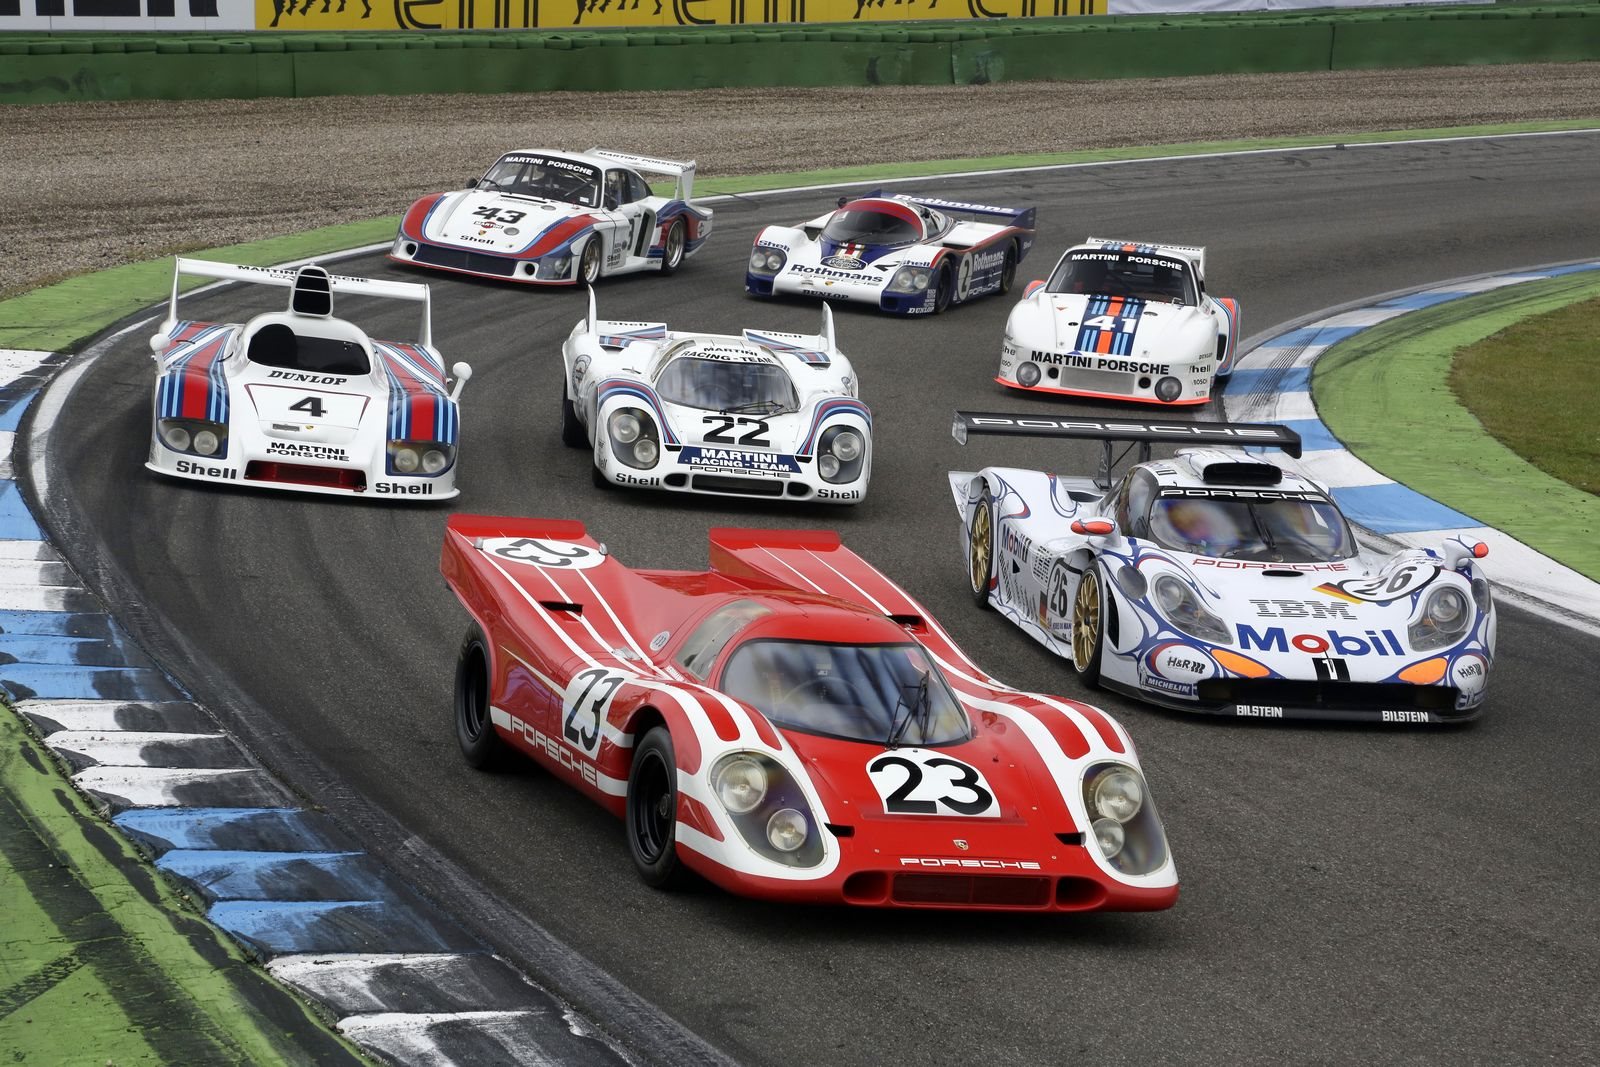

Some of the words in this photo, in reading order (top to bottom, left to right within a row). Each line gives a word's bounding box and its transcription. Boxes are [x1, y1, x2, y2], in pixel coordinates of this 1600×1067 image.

[504, 155, 544, 165] MARTINI
[547, 160, 594, 176] PORSCHE
[893, 194, 1015, 213] Rothmans
[472, 206, 527, 224] 43
[459, 234, 495, 245] Shell
[759, 240, 790, 252] Shell
[1071, 253, 1120, 262] MARTINI
[1127, 255, 1182, 270] PORSCHE
[790, 264, 884, 283] Rothmans
[960, 260, 970, 288] 2
[802, 289, 849, 299] DUNLOP
[906, 306, 934, 315] DUNLOP
[1083, 315, 1137, 333] 41
[703, 347, 758, 357] MARTINI
[1031, 351, 1093, 369] MARTINI
[1097, 359, 1170, 376] PORSCHE
[267, 370, 348, 385] DUNLOP
[288, 396, 328, 417] 4
[702, 416, 771, 448] 22
[971, 417, 1280, 438] PORSCHE
[266, 448, 350, 462] PORSCHE
[271, 442, 345, 456] MARTINI
[701, 448, 778, 463] MARTINI
[176, 460, 238, 480] Shell
[690, 466, 791, 478] PORSCHE
[615, 473, 660, 487] Shell
[375, 482, 434, 495] Shell
[817, 489, 860, 500] Shell
[1160, 490, 1327, 503] PORSCHE
[1001, 523, 1023, 558] Mobil
[1192, 558, 1350, 572] PORSCHE
[1352, 566, 1418, 596] 26
[1050, 567, 1068, 618] 26
[1248, 599, 1358, 621] IBM
[1235, 623, 1406, 657] Mobil
[1167, 656, 1191, 669] H&R
[1148, 677, 1190, 693] MICHELIN
[563, 669, 625, 751] 23
[1236, 703, 1283, 718] BILSTEIN
[1381, 709, 1429, 723] BILSTEIN
[510, 714, 600, 788] PORSCHE
[869, 756, 993, 815] 23
[900, 857, 1041, 870] PORSCHE
